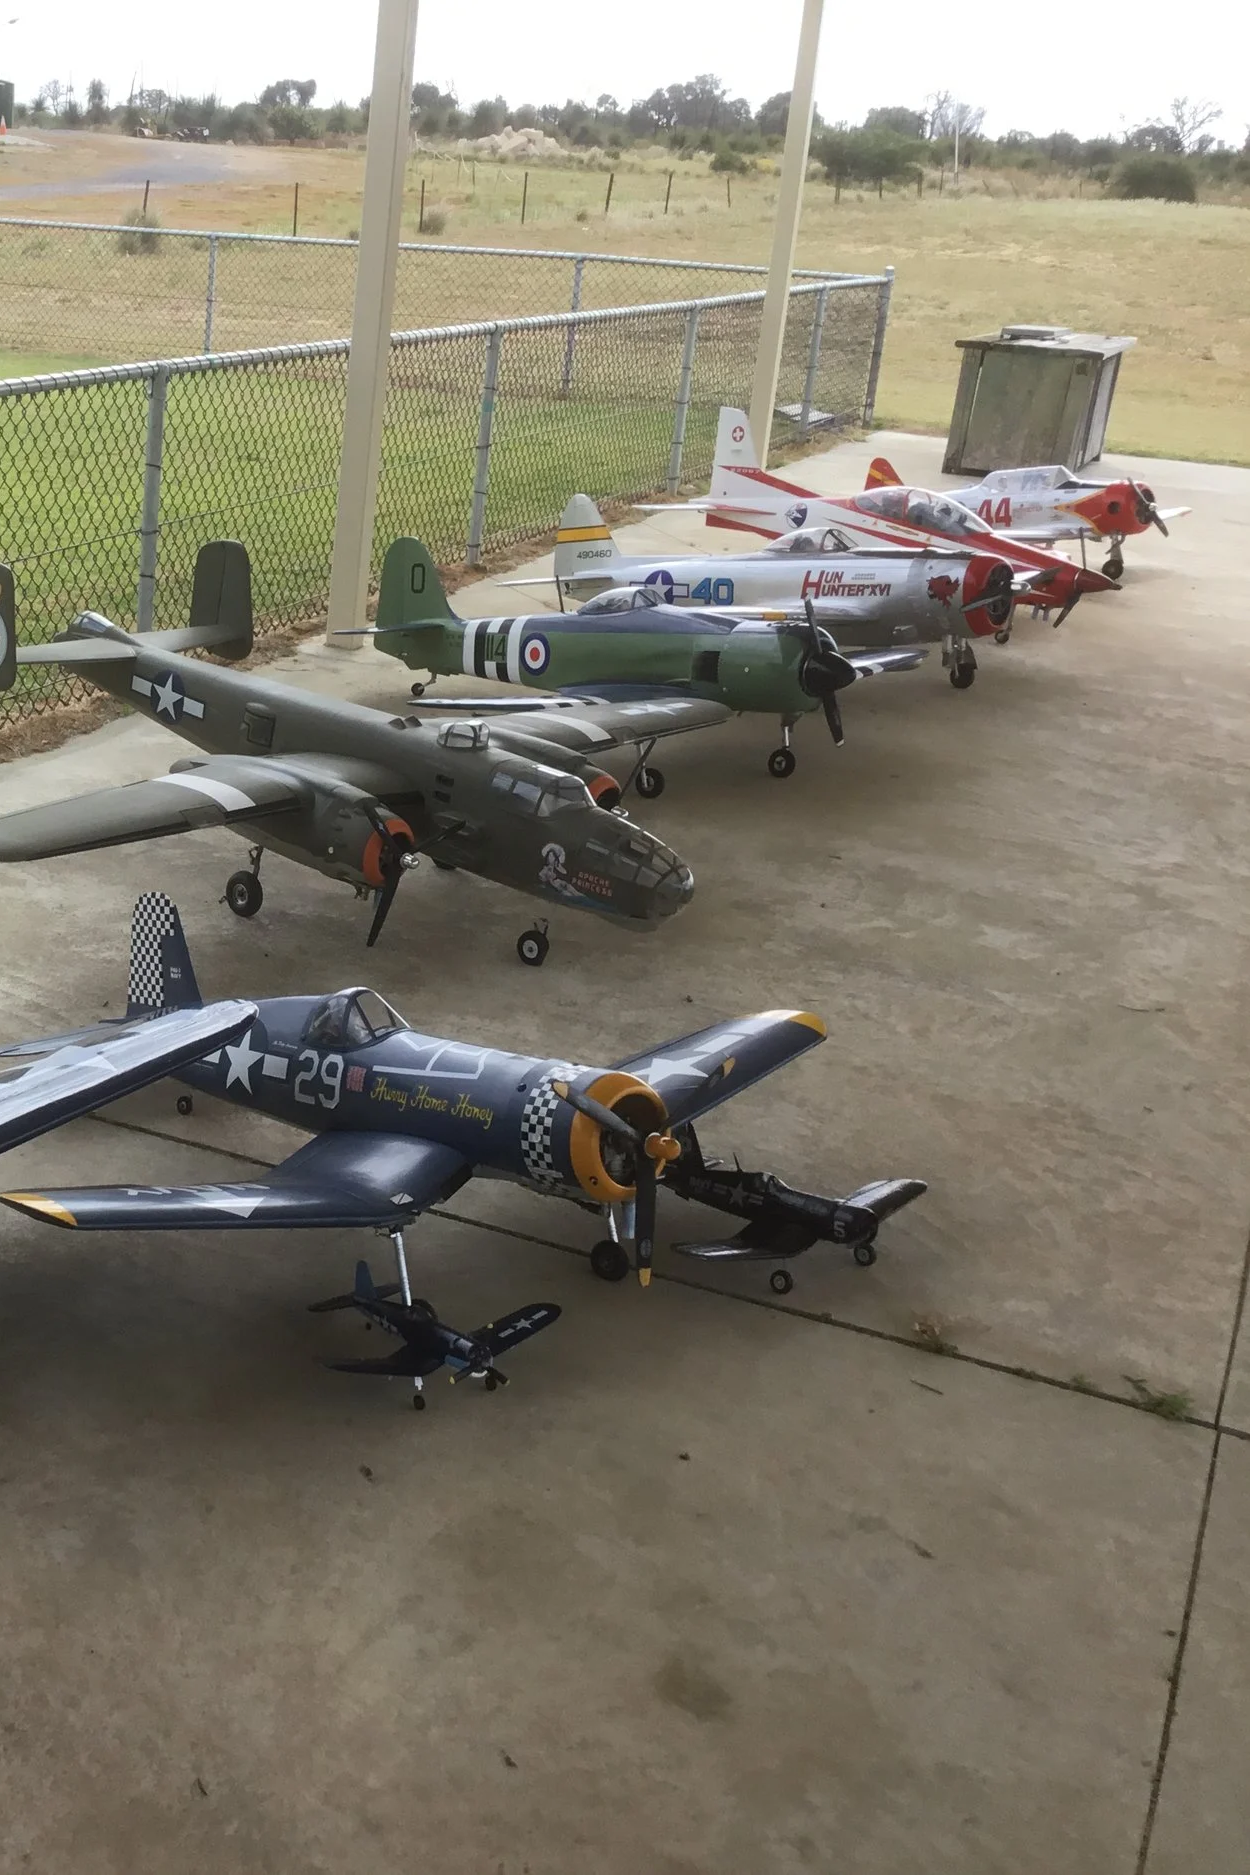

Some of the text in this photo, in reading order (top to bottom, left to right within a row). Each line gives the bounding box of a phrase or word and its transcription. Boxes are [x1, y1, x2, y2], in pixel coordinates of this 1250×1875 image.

[978, 496, 1012, 528] 44
[577, 550, 612, 559] 490460
[691, 577, 734, 606] 40
[294, 1049, 344, 1109] 29
[370, 1077, 494, 1129] Hurry Home Honey
[833, 1220, 845, 1238] 5
